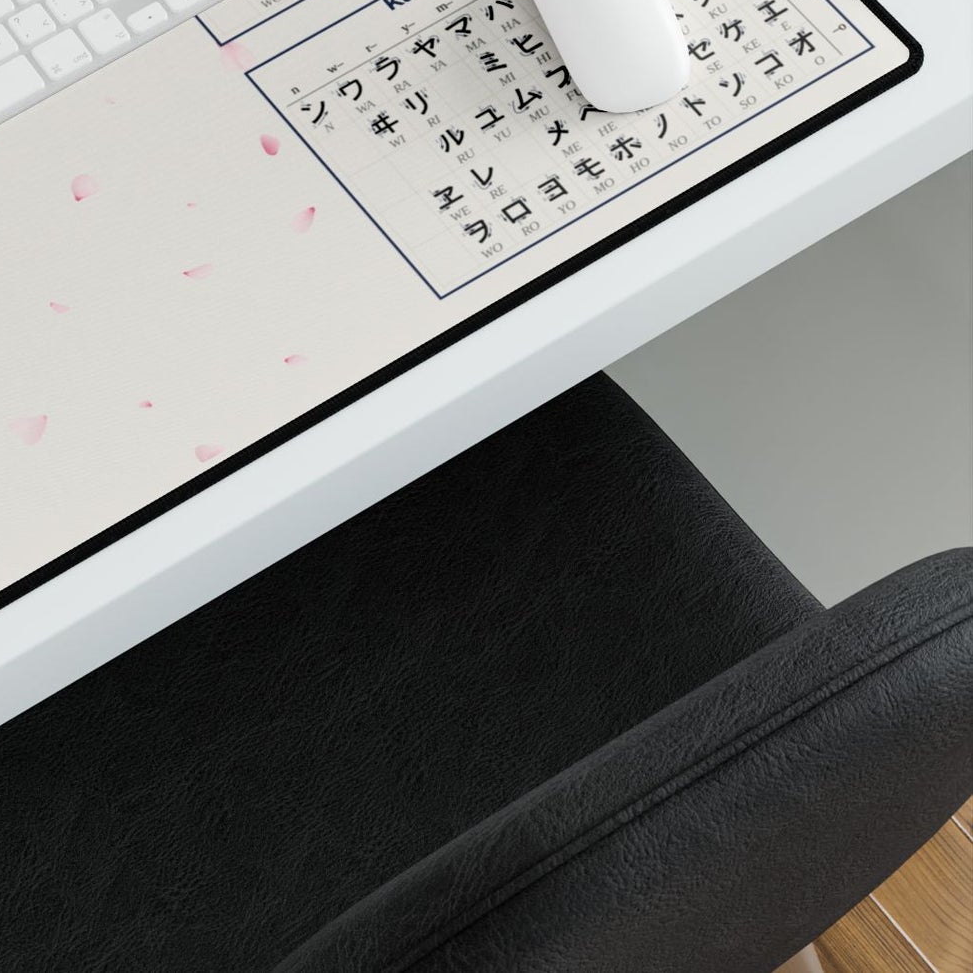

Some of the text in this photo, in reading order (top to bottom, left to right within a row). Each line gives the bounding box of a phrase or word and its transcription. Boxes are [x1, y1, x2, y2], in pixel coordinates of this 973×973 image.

[485, 0, 515, 21] ハ
[757, 0, 788, 23] エ
[444, 16, 473, 38] マ
[722, 19, 742, 42] ケ
[412, 37, 440, 58] ヤ
[465, 38, 486, 53] MA
[510, 33, 544, 55] ヒ
[687, 41, 715, 61] セ
[789, 31, 815, 56] オ
[375, 56, 401, 81] ラ
[479, 51, 508, 73] ミ
[754, 53, 784, 75] コ
[393, 79, 412, 94] RA
[498, 71, 517, 87] MI
[719, 73, 742, 97] ソ
[338, 79, 363, 101] ワ
[514, 88, 543, 111] ム
[300, 100, 325, 124] ン
[355, 99, 377, 114] WA
[405, 91, 428, 115] リ
[528, 105, 551, 122] MU
[683, 97, 706, 117] ト
[474, 108, 505, 130] ユ
[389, 134, 407, 149] WI
[440, 129, 465, 153] ル
[547, 120, 569, 147] メ
[668, 135, 688, 151] NO
[457, 148, 476, 164] RU
[562, 141, 583, 157] ME
[610, 137, 642, 161] ホ
[574, 158, 605, 177] モ
[629, 156, 650, 174] HO
[470, 167, 493, 186] レ
[593, 177, 615, 195] MO
[537, 177, 568, 202] ヨ
[450, 205, 472, 221] WE
[464, 219, 489, 244] ヲ
[481, 241, 504, 259] WO
